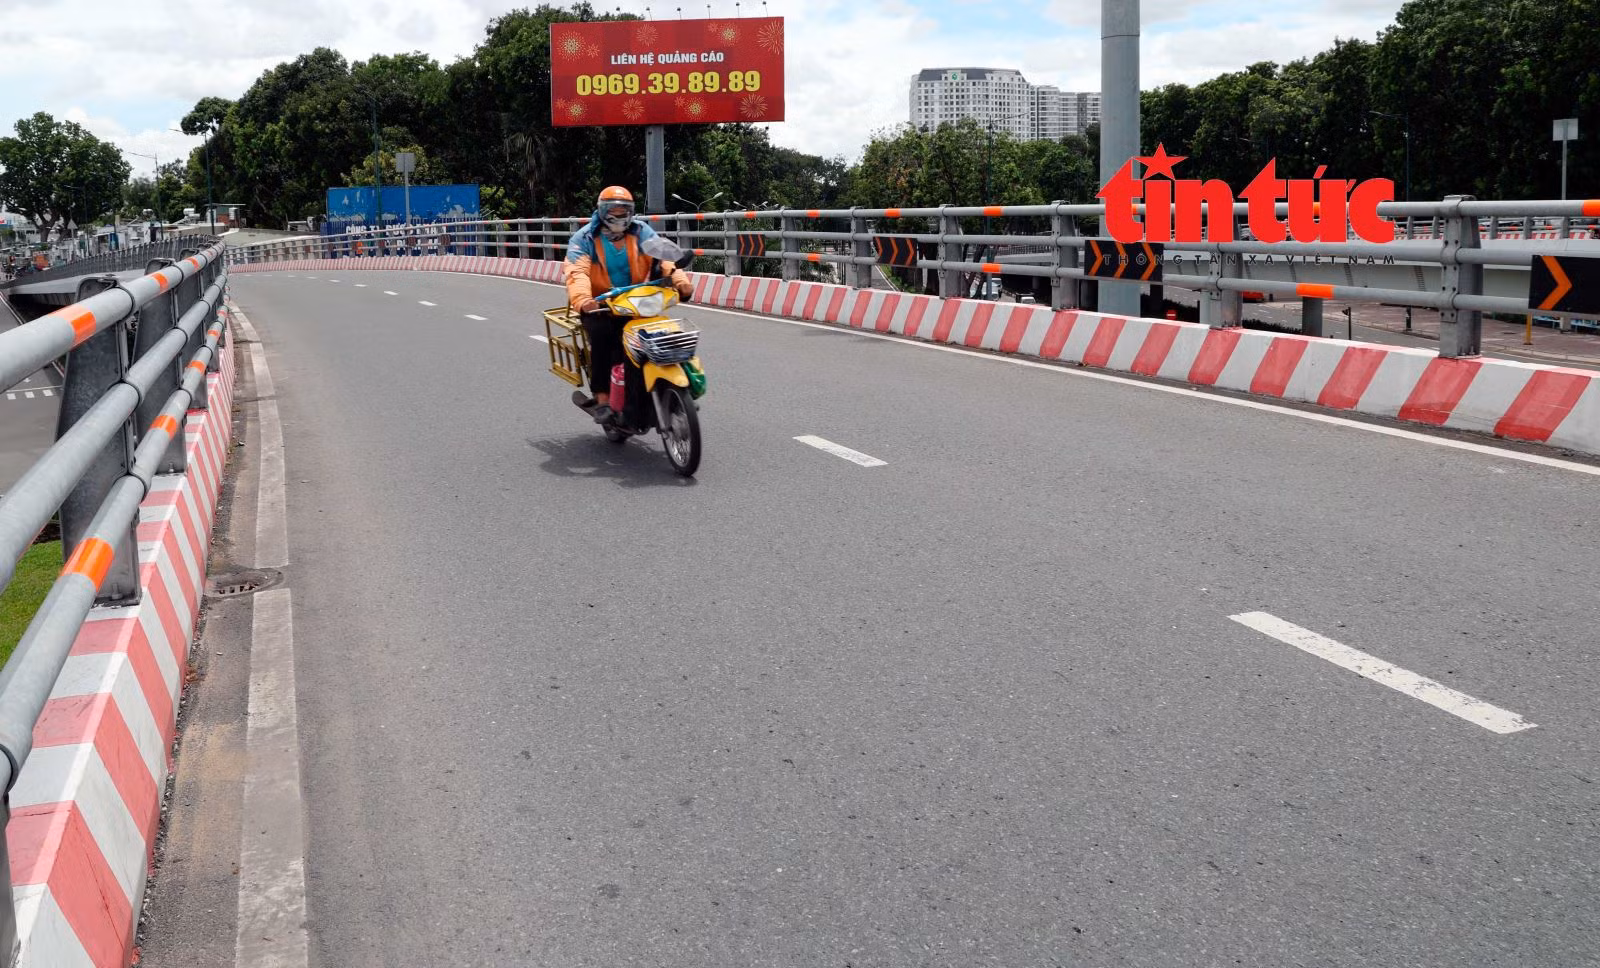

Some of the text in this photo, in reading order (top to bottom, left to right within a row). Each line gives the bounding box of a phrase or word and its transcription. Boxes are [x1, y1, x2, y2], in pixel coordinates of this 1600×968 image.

[611, 50, 724, 66] LIÊN HỆ QUẢNG CÁO
[576, 70, 761, 96] 0969.39.89.89
